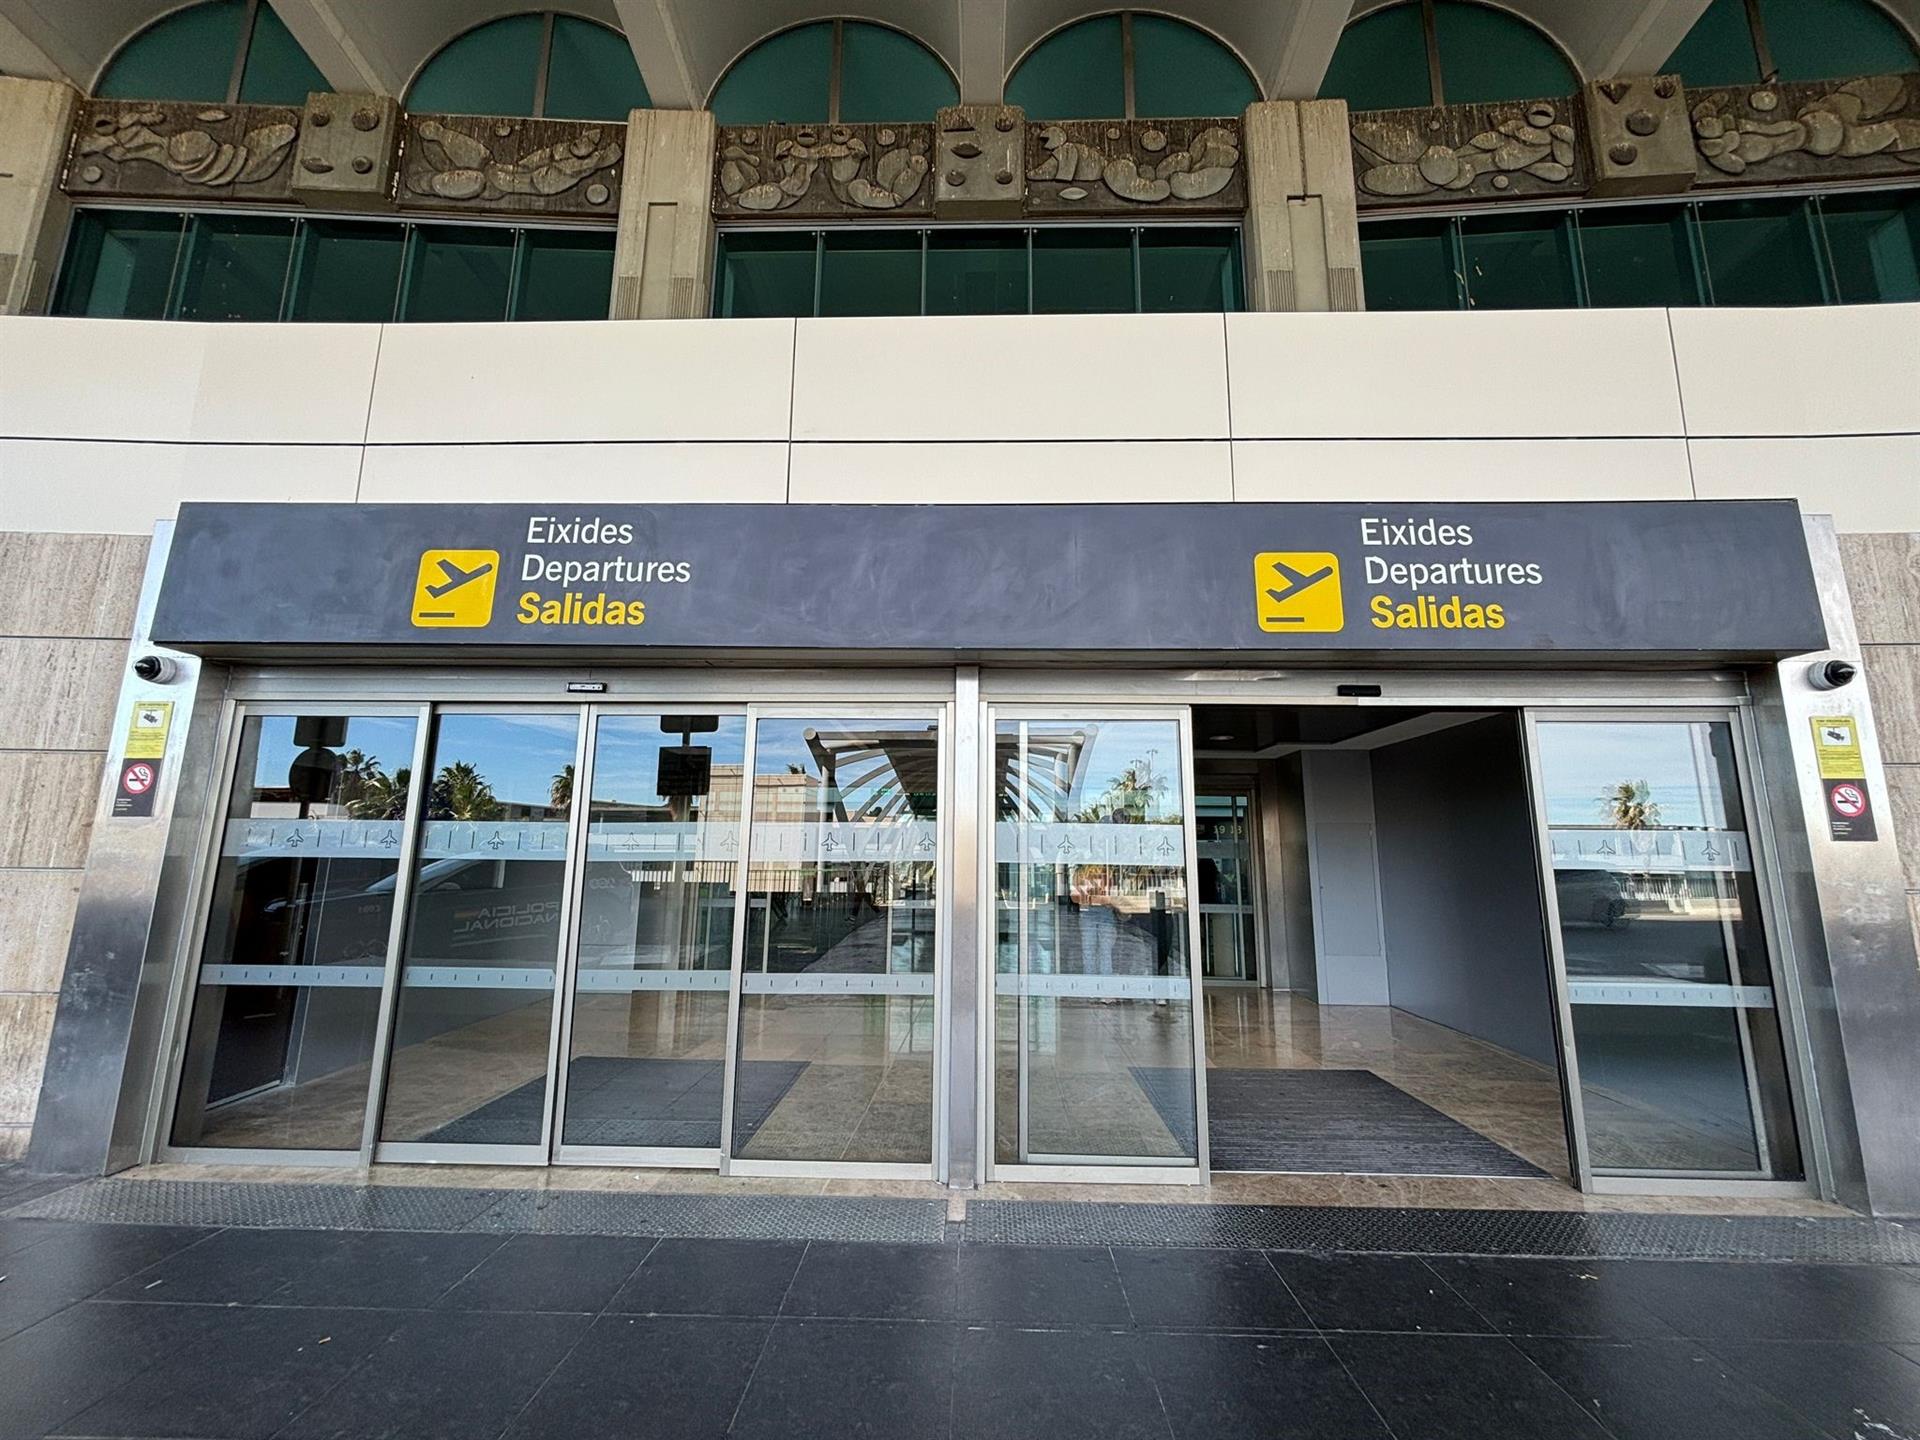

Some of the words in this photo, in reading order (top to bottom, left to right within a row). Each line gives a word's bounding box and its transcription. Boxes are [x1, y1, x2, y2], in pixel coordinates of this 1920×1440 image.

[527, 516, 633, 544] Eixides
[1360, 518, 1473, 546] Eixides
[521, 554, 691, 587] Departures
[1364, 556, 1543, 590] Departures
[516, 592, 645, 625] Salidas
[1370, 595, 1505, 629] Salidas
